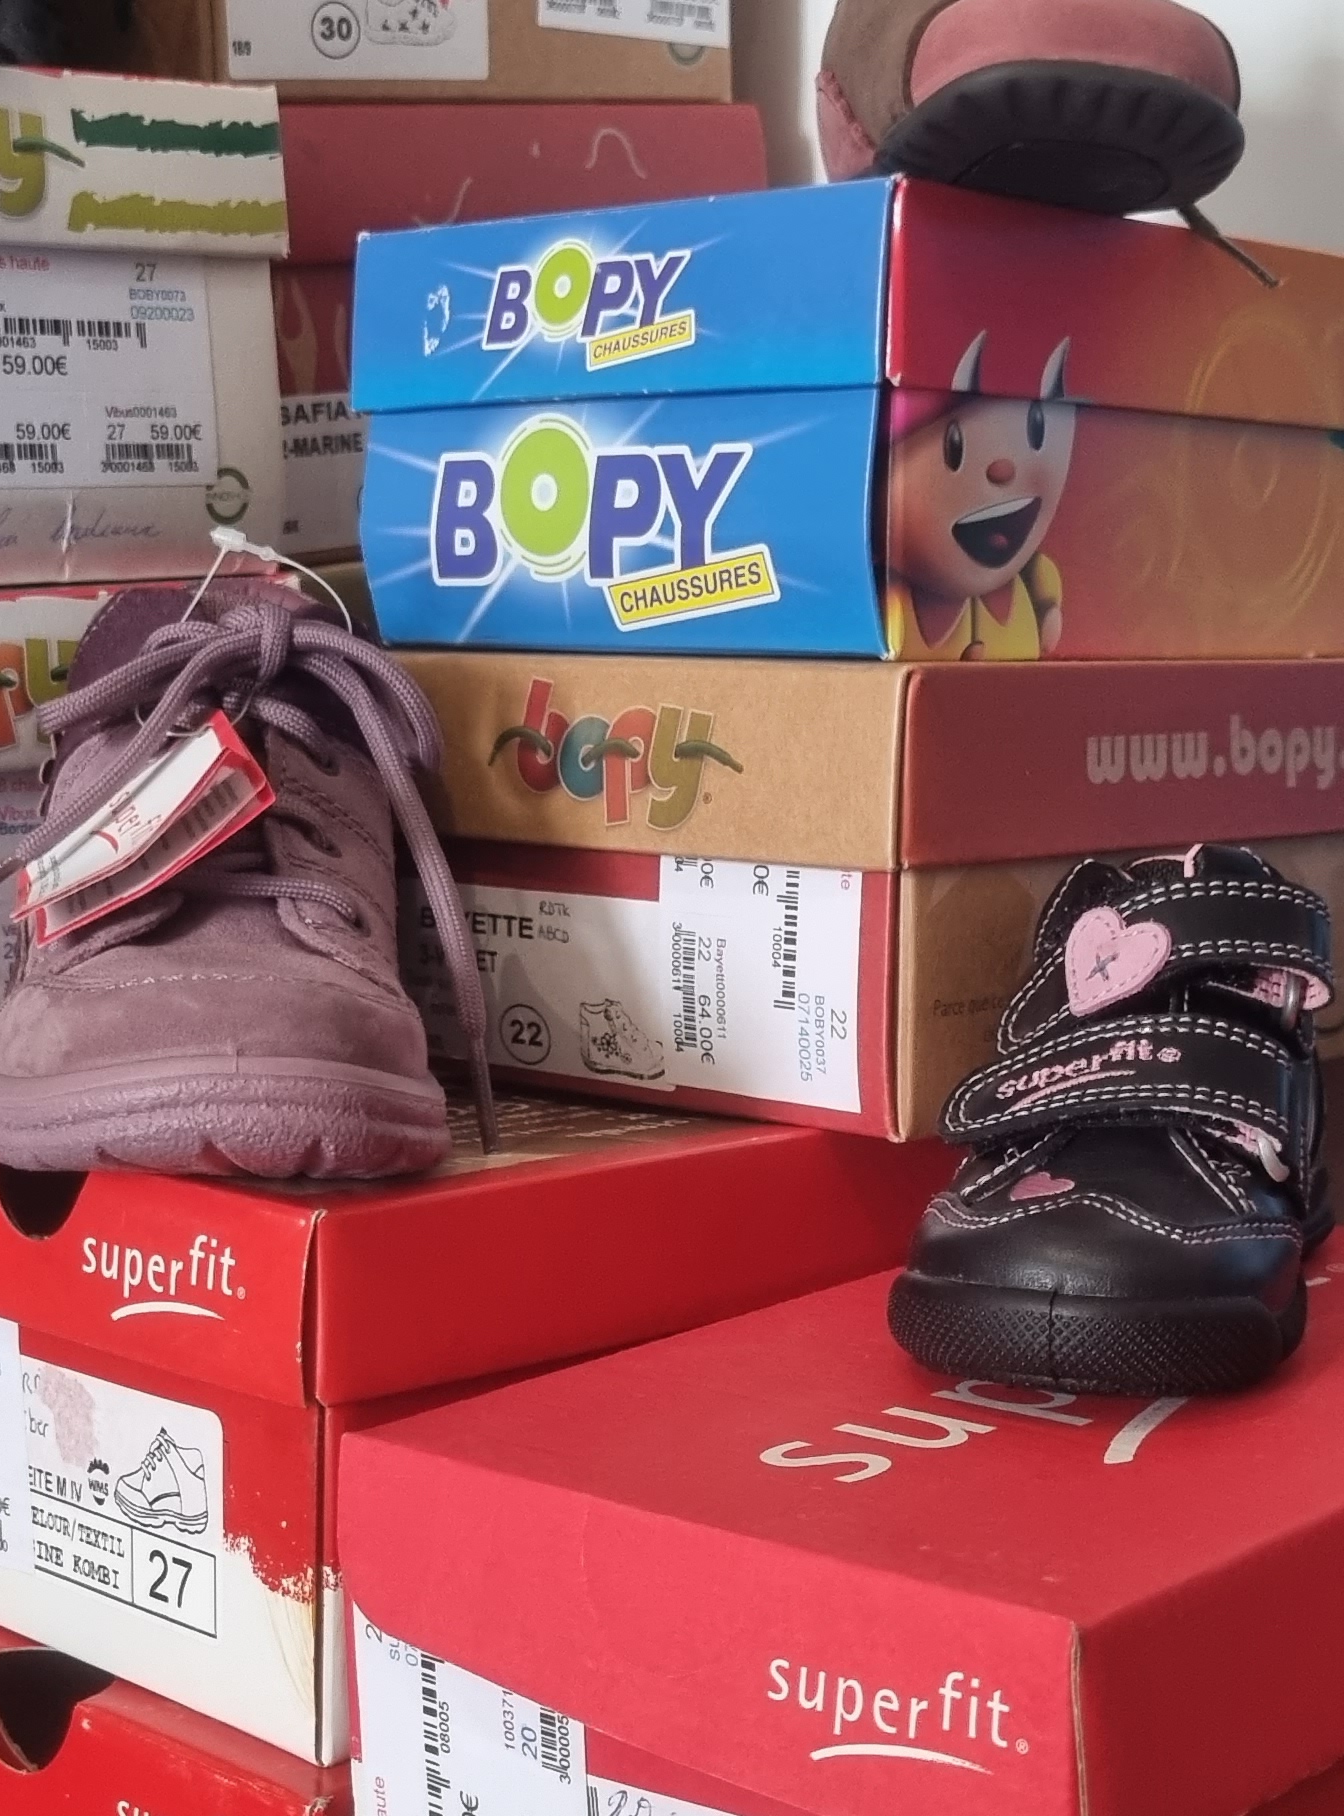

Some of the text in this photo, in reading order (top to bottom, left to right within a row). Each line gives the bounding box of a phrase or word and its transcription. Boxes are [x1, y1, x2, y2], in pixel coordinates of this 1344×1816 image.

[320, 15, 353, 42] 30
[134, 262, 157, 282] 27
[484, 240, 691, 350] BOPY
[592, 320, 689, 360] CHAUSSURES
[1, 354, 69, 376] 59.00€
[15, 422, 72, 441] 59.00€
[107, 423, 203, 441] 27 59.00€
[434, 415, 752, 583] BOPY
[619, 561, 762, 614] CHAUSSURES
[517, 676, 714, 832] bopy
[421, 907, 534, 940] BETTE
[771, 926, 782, 968] 10004
[698, 937, 715, 1065] 22 64.00€
[830, 1008, 847, 1041] 22
[510, 1019, 544, 1047] 22
[798, 993, 813, 1082] 07140025
[814, 995, 827, 1075] BOBY0037
[995, 1039, 1154, 1100] superfit
[81, 1234, 237, 1299] superfit
[56, 1475, 68, 1496] M
[31, 1505, 125, 1558] ELOUR/TEXTIL
[73, 1553, 120, 1590] KOMBI
[149, 1549, 193, 1609] 27
[766, 1657, 1010, 1749] superfit
[438, 1700, 451, 1754] 08005
[521, 1726, 538, 1760] 20
